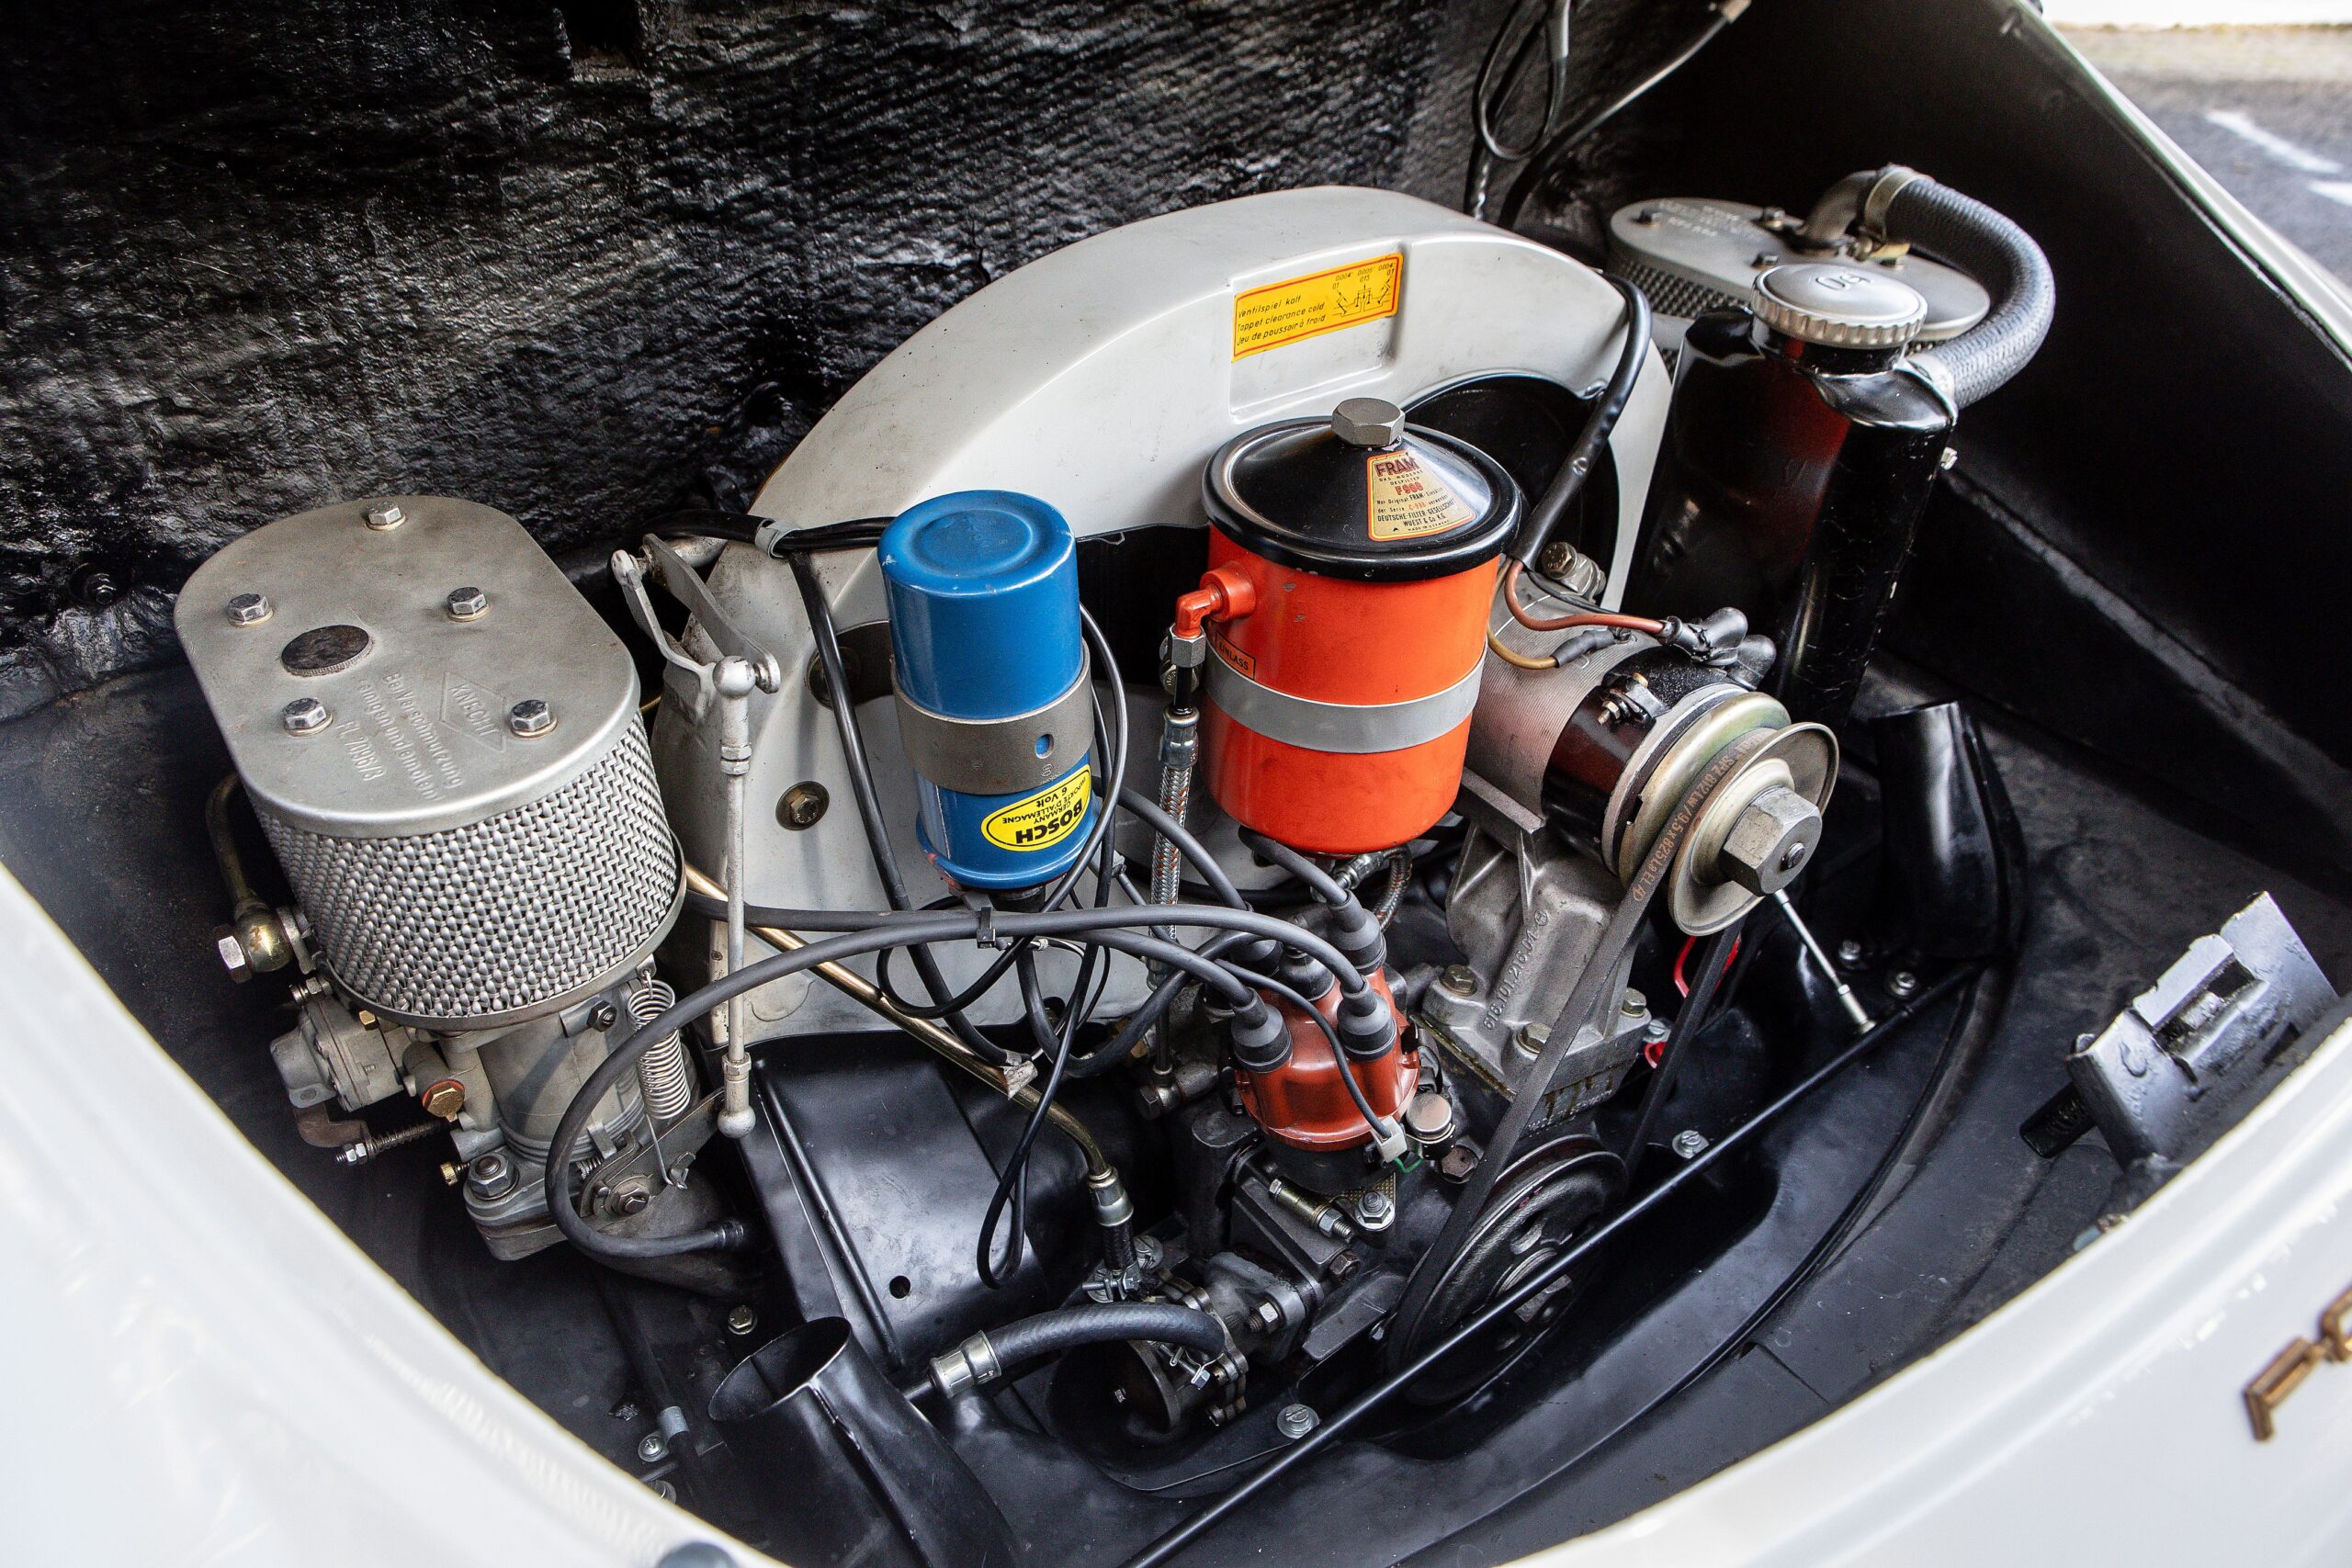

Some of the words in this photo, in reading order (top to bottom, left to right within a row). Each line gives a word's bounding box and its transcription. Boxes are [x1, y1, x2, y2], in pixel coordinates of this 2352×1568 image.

[1238, 299, 1282, 319] Ventilspiel
[1285, 295, 1302, 306] kalt
[1238, 318, 1263, 333] Tappet
[1265, 308, 1306, 325] clearance
[1307, 301, 1326, 313] cold
[1237, 335, 1250, 346] Jeu
[1251, 331, 1262, 341] de
[1262, 322, 1298, 340] poussoir
[1306, 314, 1327, 326] froid
[1374, 457, 1420, 477] FRAM
[1219, 642, 1249, 671] EINLASS
[1035, 794, 1059, 808] Volt
[1061, 785, 1068, 796] 6
[1063, 776, 1086, 804] IMPORTE
[1001, 799, 1062, 824] D'ALLEMAGNE
[1015, 797, 1082, 844] BOSCH
[1033, 800, 1071, 825] GERMANY
